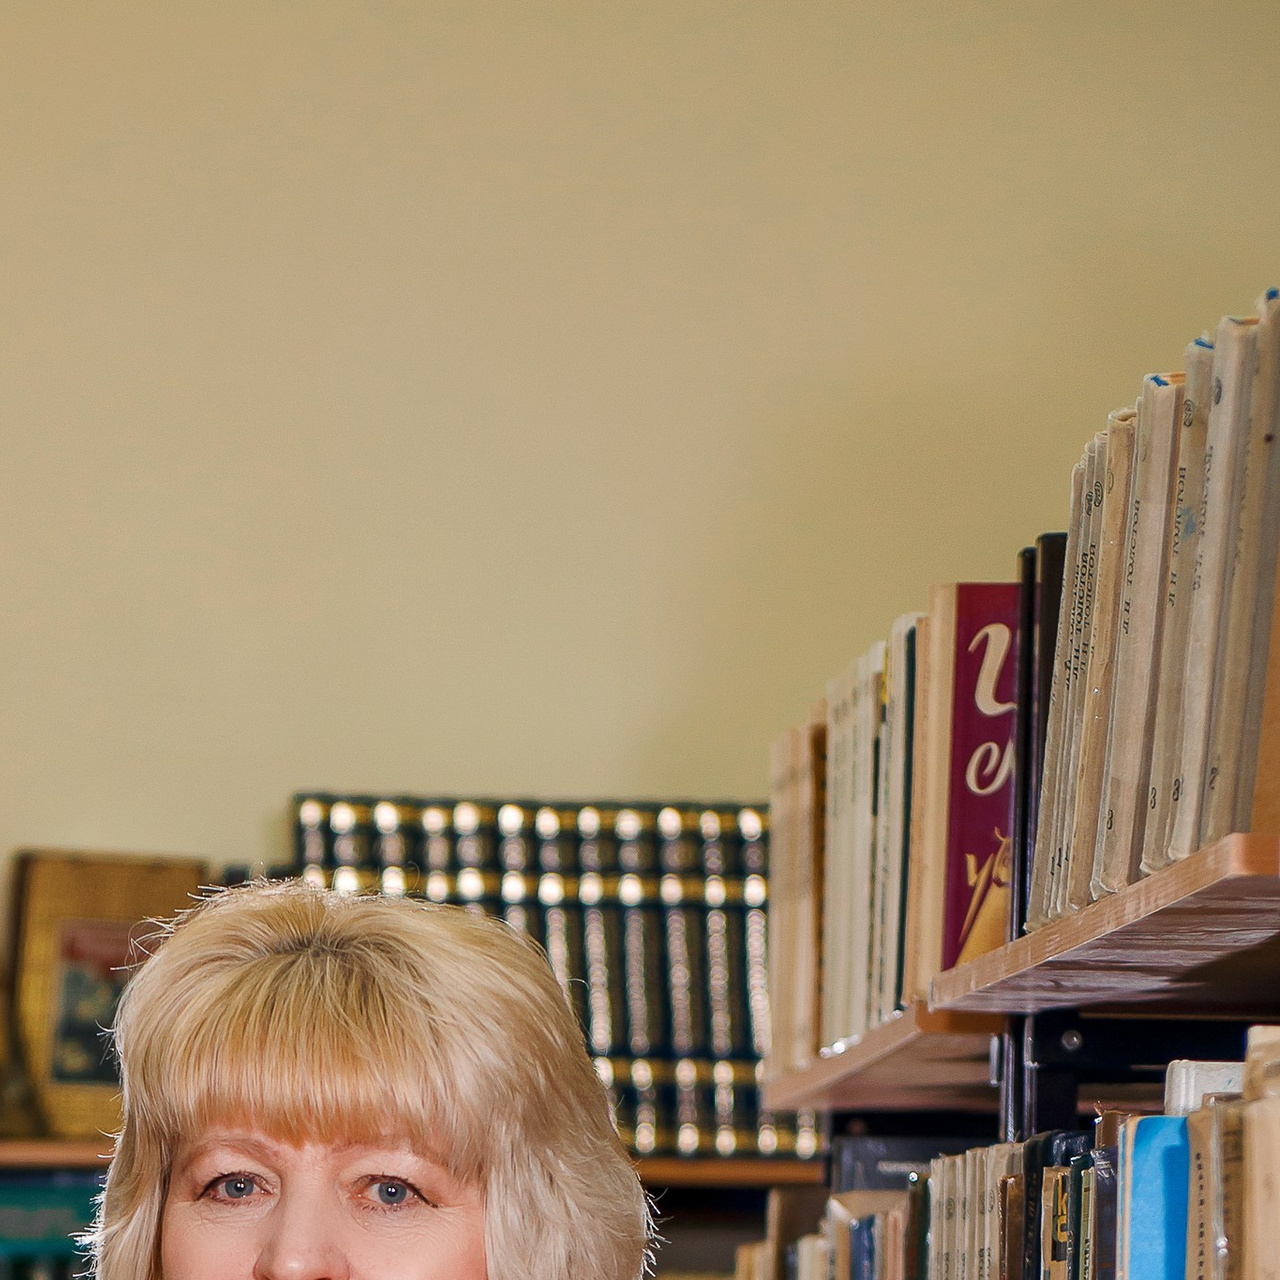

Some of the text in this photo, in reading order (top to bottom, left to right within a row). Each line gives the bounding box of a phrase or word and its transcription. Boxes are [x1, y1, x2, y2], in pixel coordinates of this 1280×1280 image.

[1083, 541, 1097, 628] ТОЛСТОЙ
[1126, 498, 1141, 586] ТОЛСТОЙ
[1074, 550, 1089, 636] ТОЛСТОЙ
